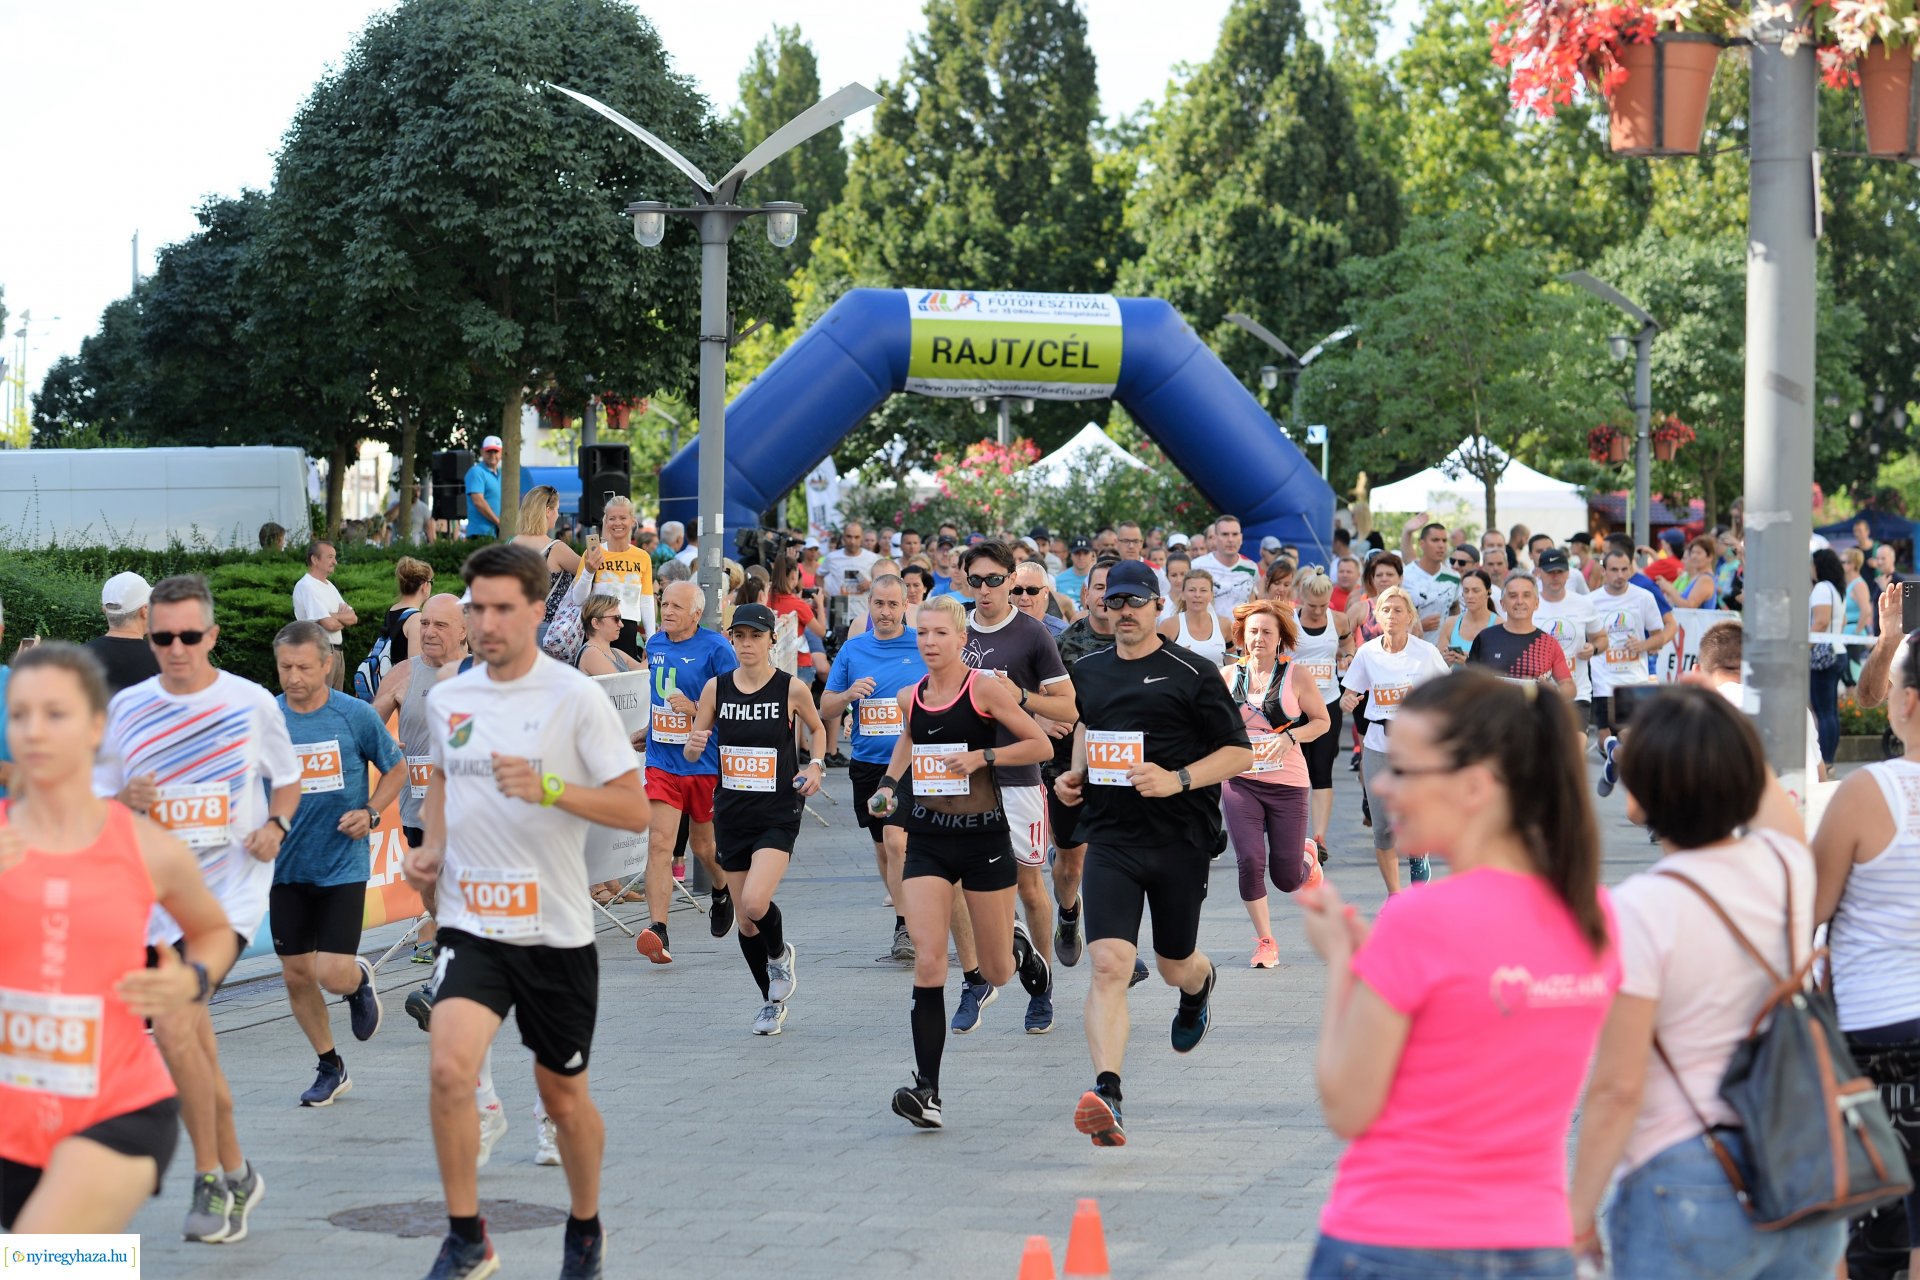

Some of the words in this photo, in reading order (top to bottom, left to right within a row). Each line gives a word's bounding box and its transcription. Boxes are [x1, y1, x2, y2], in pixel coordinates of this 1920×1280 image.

[988, 298, 1110, 310] FUTÓFESZTIVÁL
[931, 333, 1099, 369] RAJT/CÉL
[719, 702, 780, 720] ATHLETE
[861, 706, 898, 720] 1065
[653, 714, 687, 729] 1135
[1089, 743, 1135, 763] 1124
[412, 765, 433, 780] 11
[725, 756, 770, 773] 1085
[914, 756, 951, 774] 108
[154, 797, 222, 823] 1078
[931, 812, 978, 828] NIKE
[1028, 820, 1041, 848] 11
[464, 883, 527, 908] 1001
